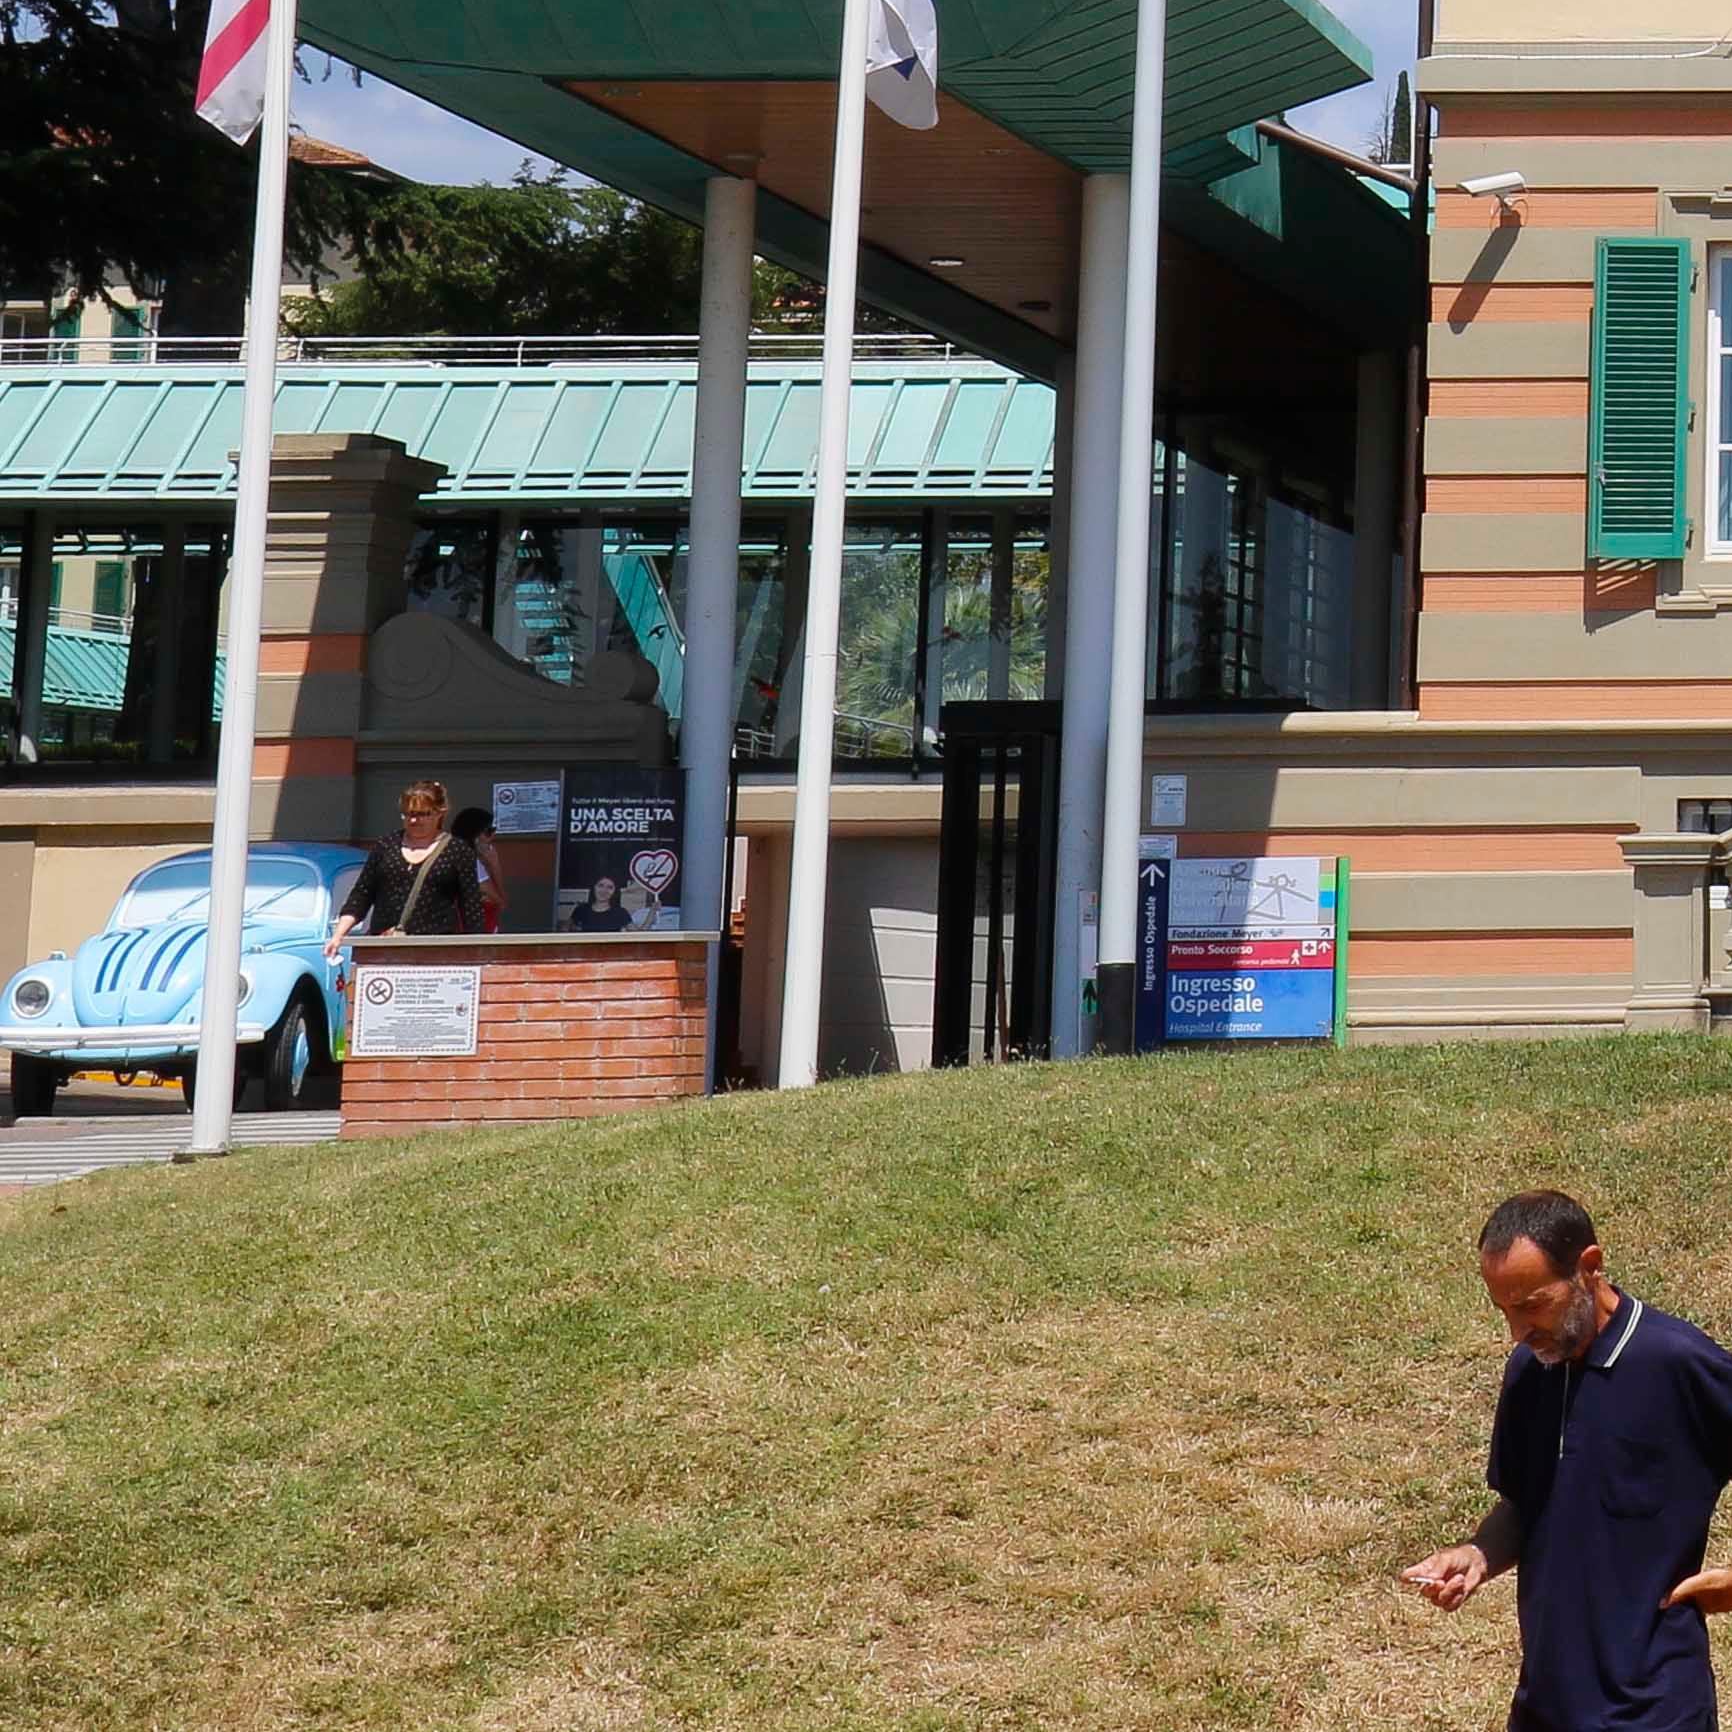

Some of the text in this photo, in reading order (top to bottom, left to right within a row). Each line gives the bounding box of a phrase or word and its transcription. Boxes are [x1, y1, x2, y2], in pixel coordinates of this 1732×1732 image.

[571, 808, 675, 821] UNA SCELTA
[570, 821, 650, 833] D'AMORE
[1171, 929, 1264, 940] Fondazione Meyer
[1143, 896, 1157, 991] Ingresso Ospedale
[1171, 945, 1253, 955] Pronto Soccorso
[1171, 975, 1256, 996] Ingresso
[1170, 995, 1264, 1016] Ospedale
[1168, 1021, 1262, 1035] Hospital Entrance
